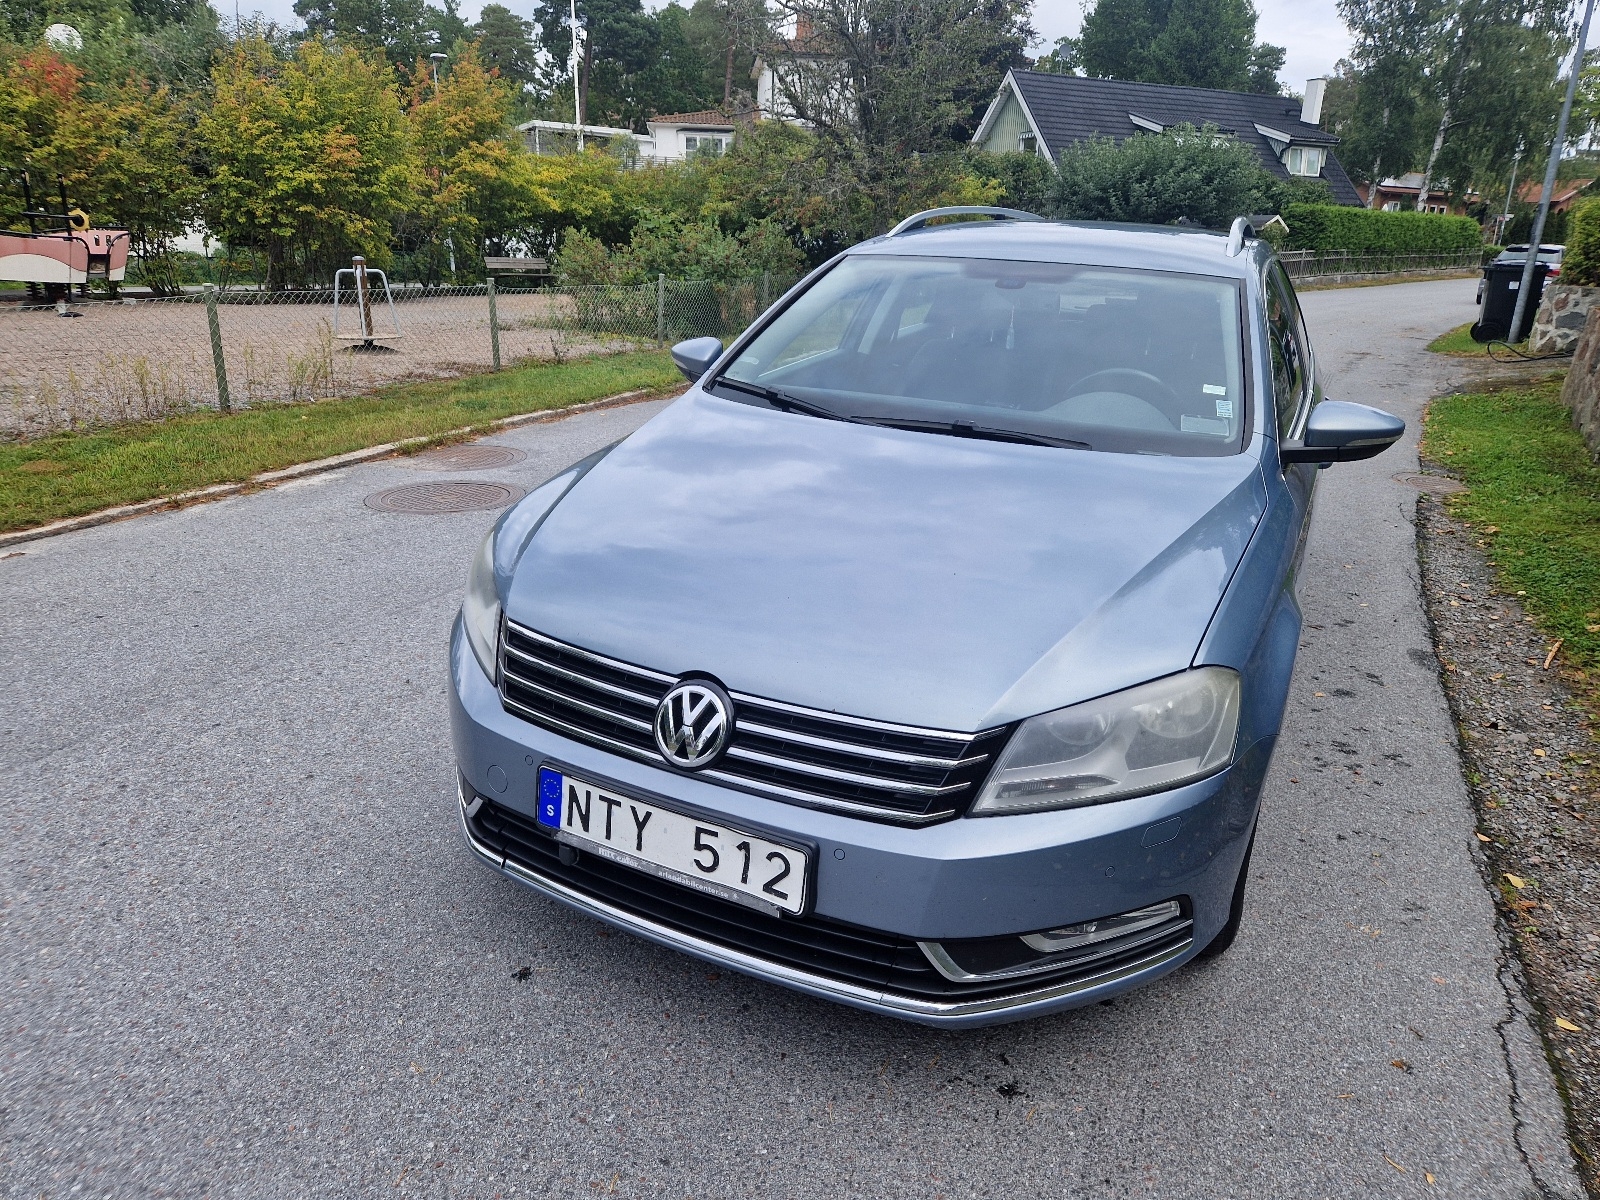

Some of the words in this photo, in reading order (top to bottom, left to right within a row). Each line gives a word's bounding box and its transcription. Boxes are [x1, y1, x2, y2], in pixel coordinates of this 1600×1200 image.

[546, 804, 555, 817] S
[566, 784, 653, 852] NTY
[693, 825, 791, 901] 512
[658, 870, 729, 899] arlandabilcenter.se
